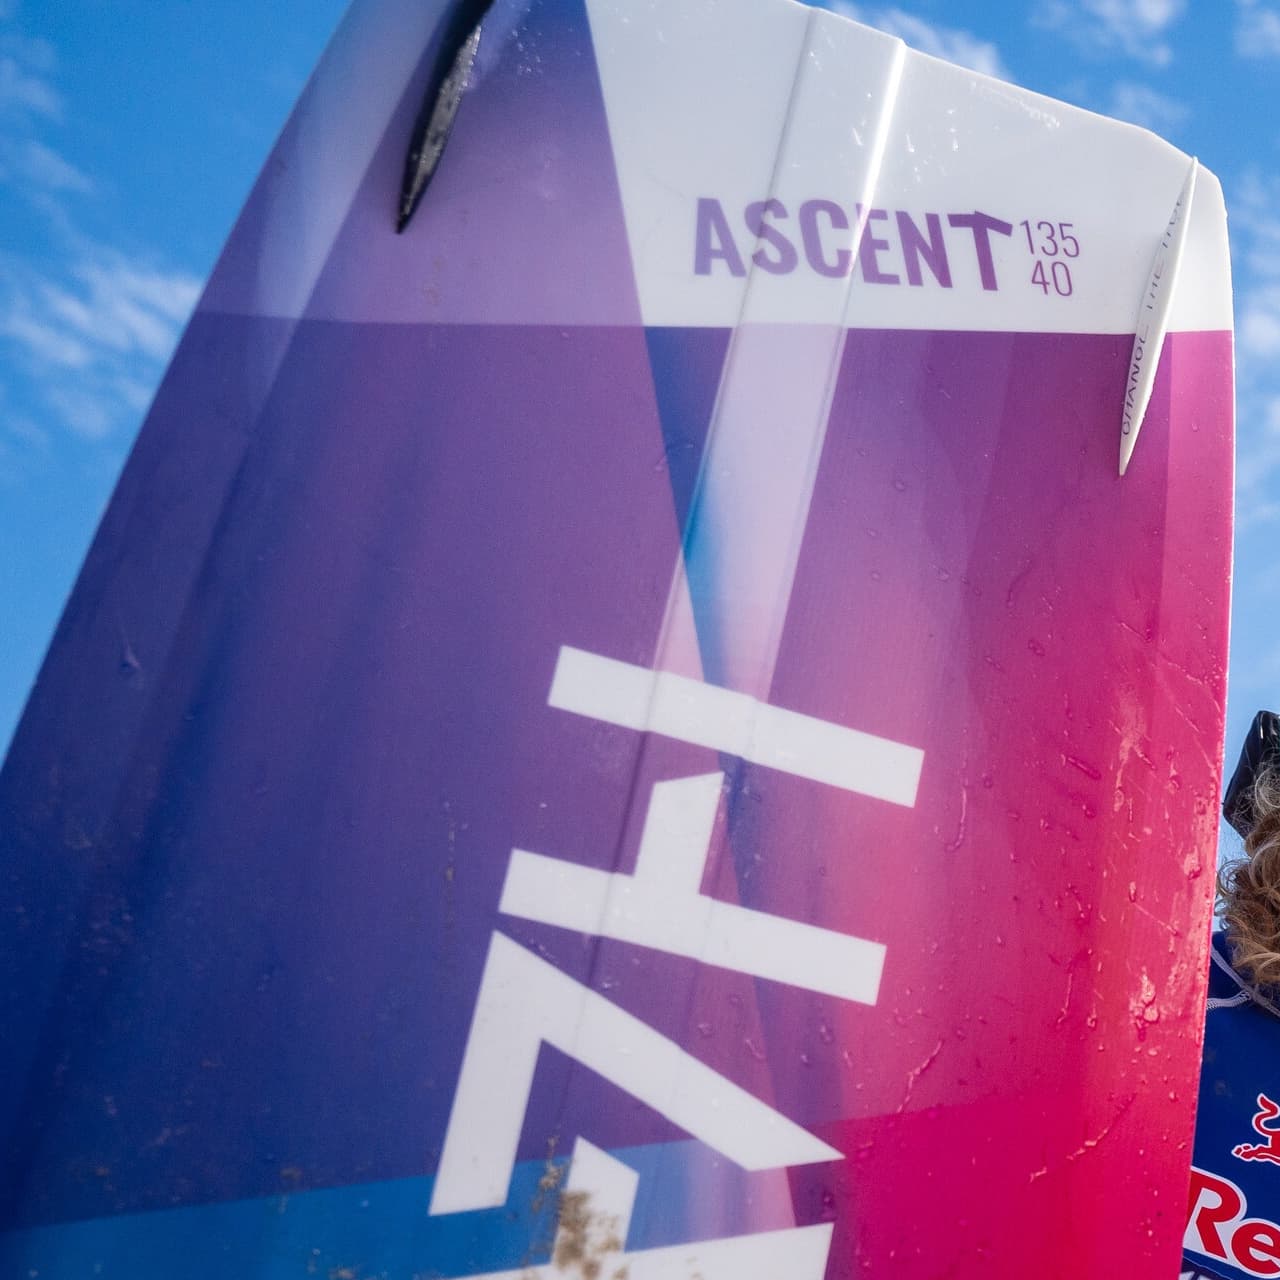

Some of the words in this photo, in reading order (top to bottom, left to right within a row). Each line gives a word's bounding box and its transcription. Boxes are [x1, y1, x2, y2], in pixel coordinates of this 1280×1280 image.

[694, 196, 1013, 292] ASCENT
[1019, 219, 1081, 259] 135
[1030, 260, 1074, 298] 40
